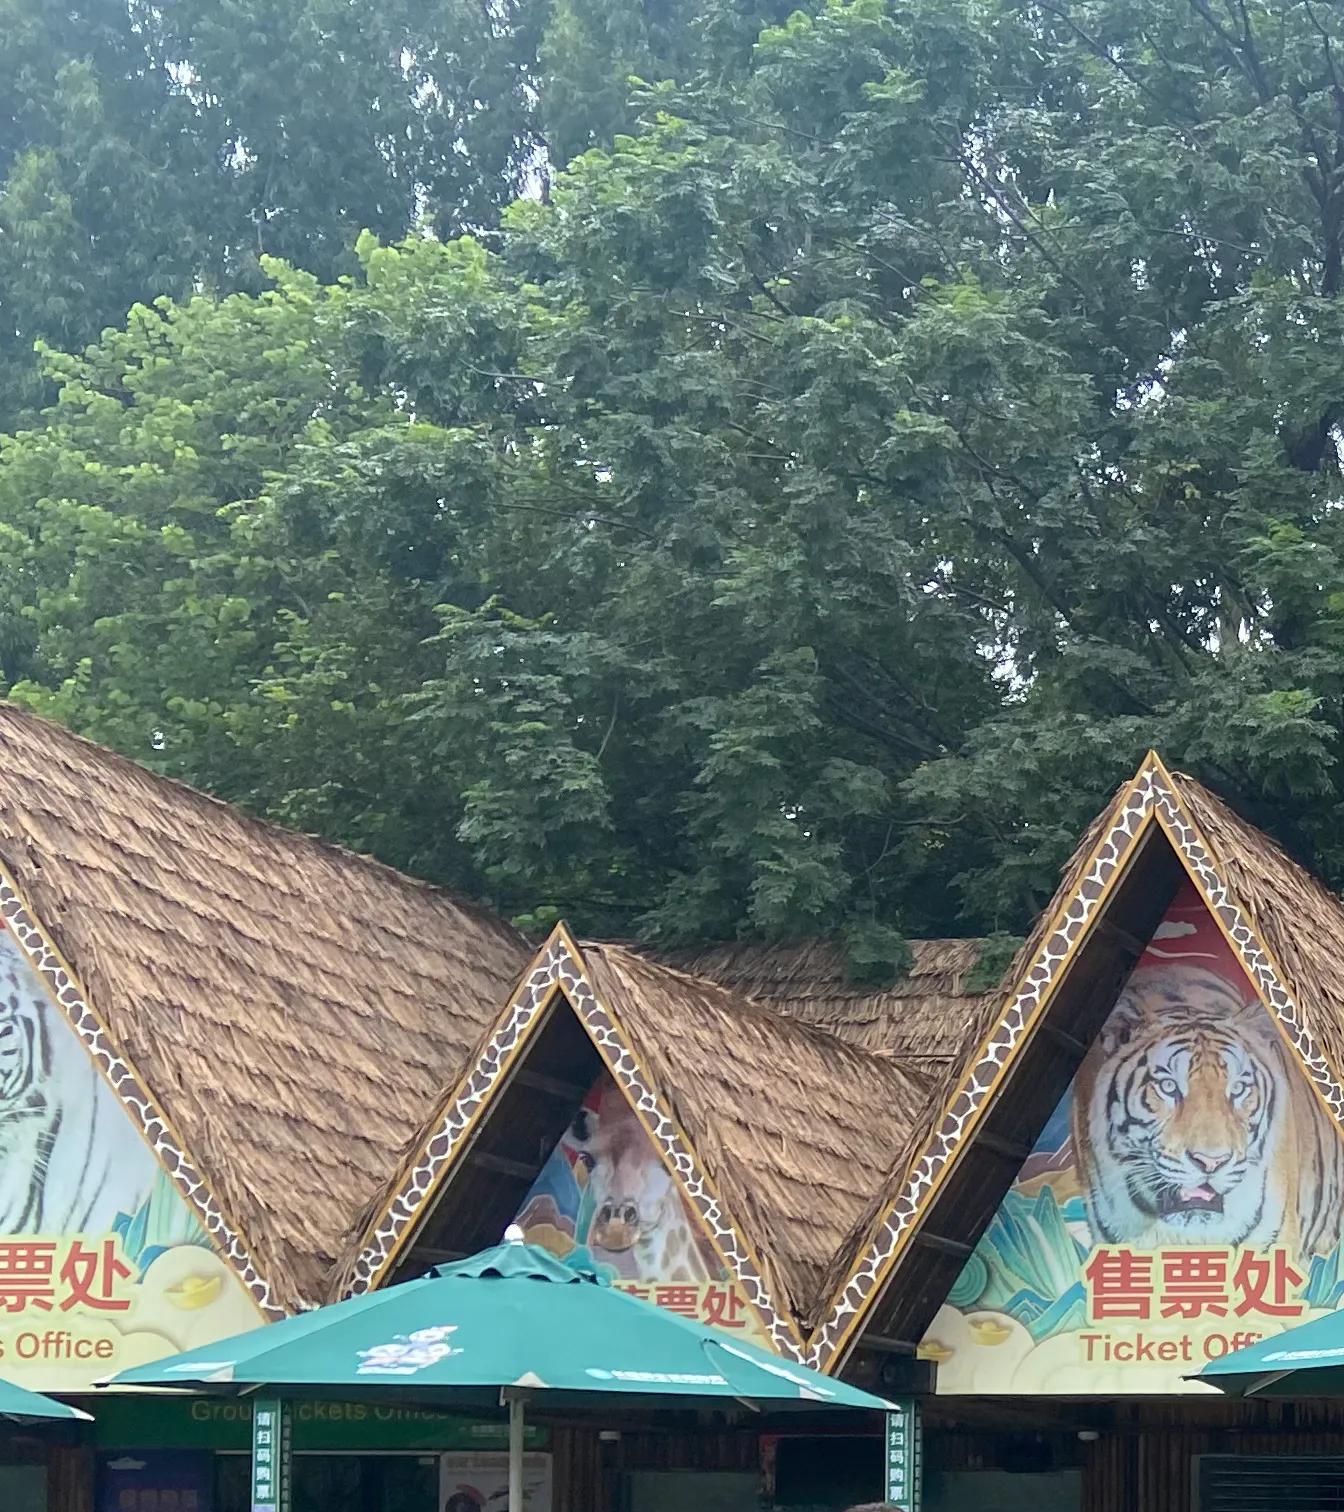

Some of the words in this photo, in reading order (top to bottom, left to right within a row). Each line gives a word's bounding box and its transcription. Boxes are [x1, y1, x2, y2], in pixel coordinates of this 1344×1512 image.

[1086, 1249, 1304, 1319] 售票处
[15, 1331, 114, 1359] Office
[1079, 1333, 1193, 1362] Ticket
[191, 1401, 250, 1422] Grou
